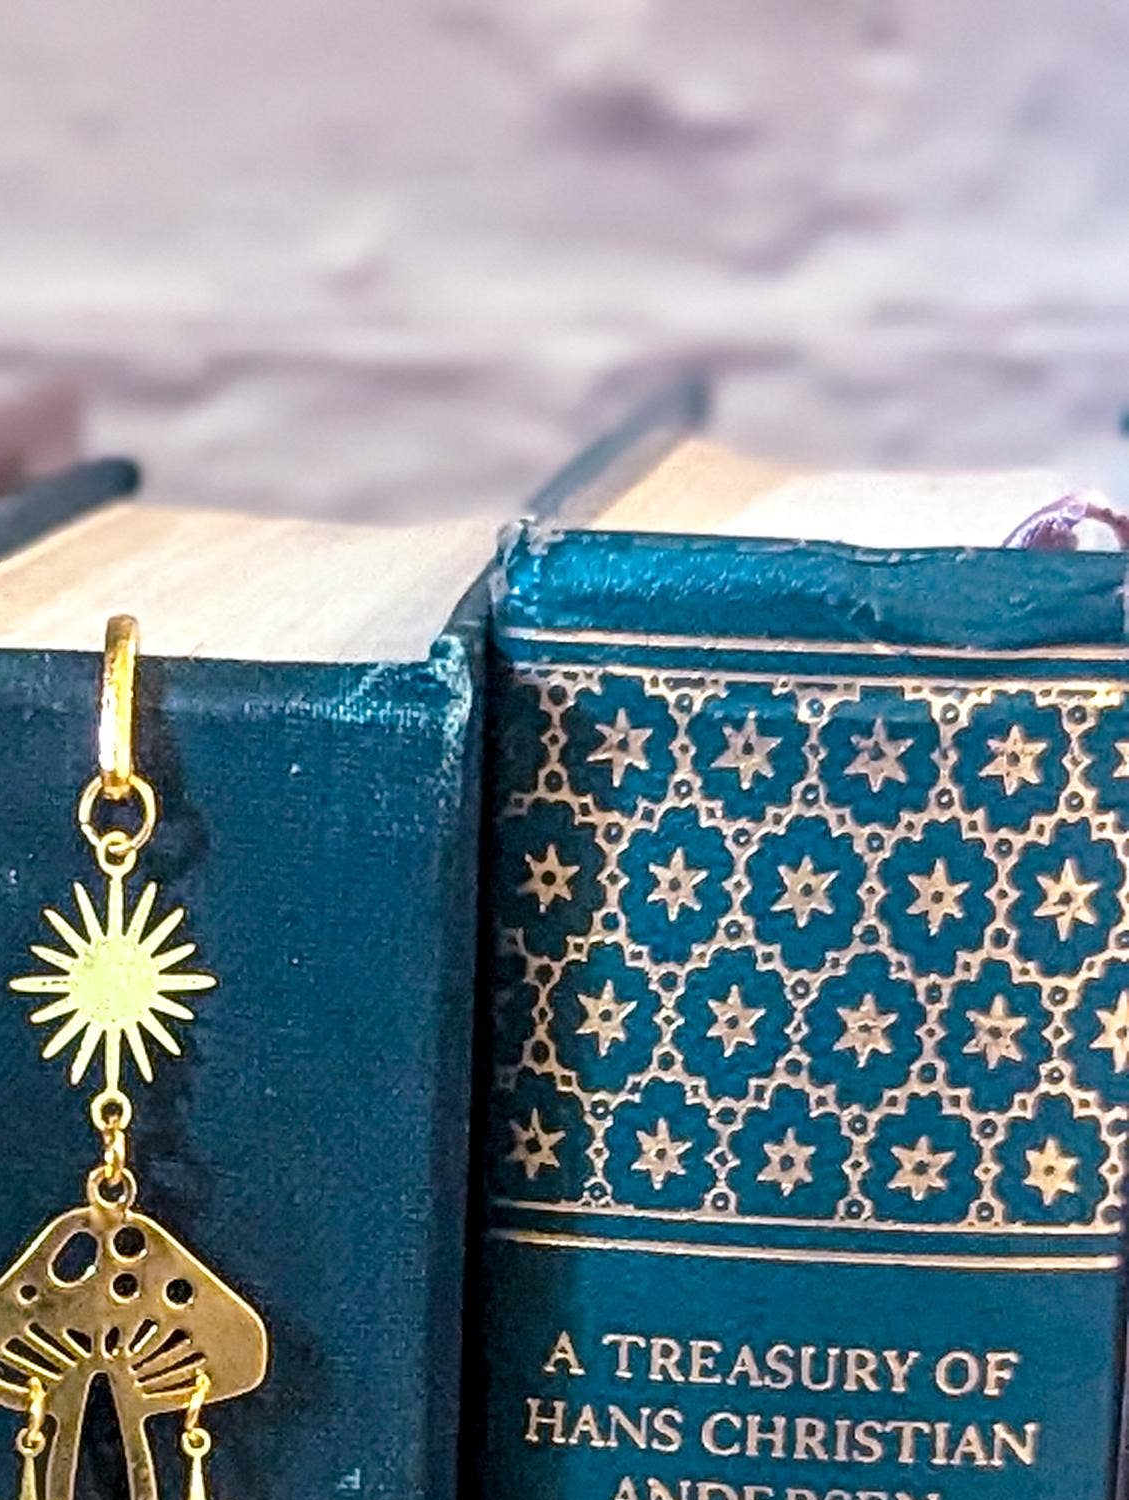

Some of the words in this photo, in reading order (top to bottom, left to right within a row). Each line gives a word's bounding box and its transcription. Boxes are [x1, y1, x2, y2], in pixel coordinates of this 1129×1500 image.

[542, 1330, 585, 1376] A
[601, 1333, 921, 1393] TREASURY
[934, 1350, 1020, 1396] OF
[524, 1397, 684, 1452] HANS
[700, 1411, 1041, 1468] CHRISTIAN
